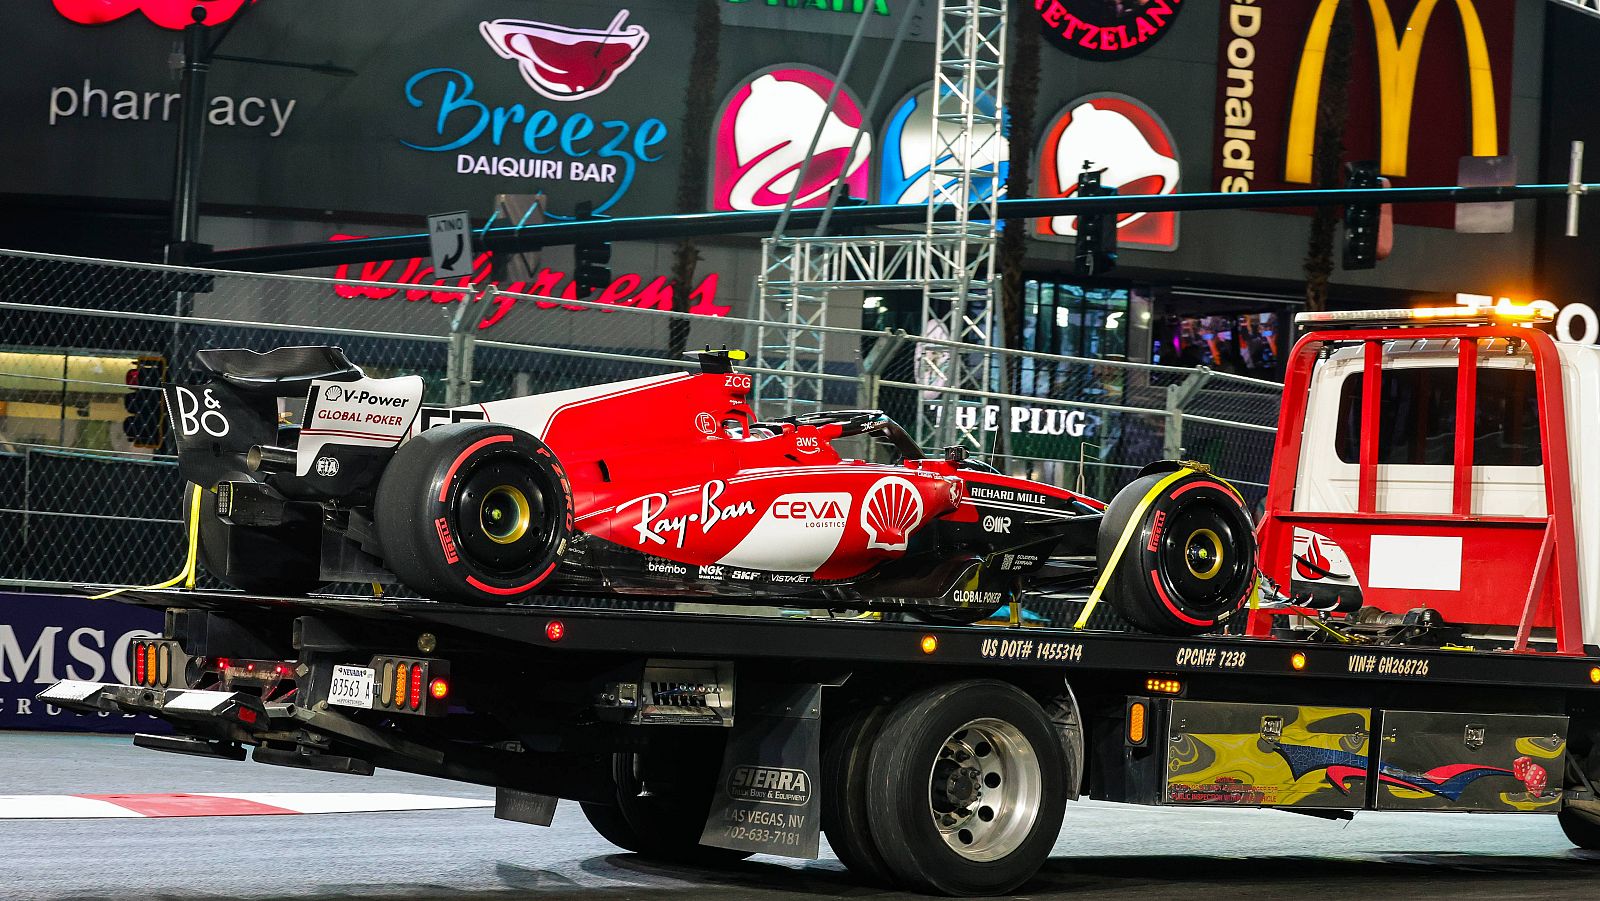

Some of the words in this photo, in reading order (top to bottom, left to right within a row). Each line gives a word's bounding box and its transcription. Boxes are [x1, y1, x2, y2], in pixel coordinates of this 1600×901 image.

[1034, 0, 1180, 51] ETZELAN
[1221, 0, 1262, 194] Donald's
[400, 67, 668, 219] Breeze
[457, 154, 563, 180] DAIQUIRI
[569, 162, 617, 184] BAR
[724, 375, 751, 389] ZCG
[344, 389, 409, 408] V-Power
[318, 409, 362, 423] GLOBAL
[364, 413, 403, 427] POKER
[1010, 406, 1087, 437] PLUG
[796, 436, 818, 447] aws
[971, 487, 1014, 501] RICHARD
[1016, 493, 1046, 505] MILLE
[435, 517, 459, 564] PIRELLI
[1147, 510, 1167, 553] PIRELLI
[648, 561, 687, 574] brembo
[698, 565, 724, 576] NGK
[731, 570, 761, 581] SKF
[953, 590, 983, 603] GLOBAL
[981, 639, 998, 657] US
[1000, 640, 1033, 658] DOT#
[1036, 642, 1083, 661] 1455314
[1176, 647, 1216, 666] CPCN#
[1219, 651, 1247, 668] 7238
[343, 668, 363, 678] NEVADA
[1348, 655, 1377, 673] VIN#
[1378, 656, 1430, 675] GH268726
[332, 678, 360, 698] 83563
[365, 681, 370, 699] A
[732, 768, 806, 791] SIERRA
[767, 790, 774, 799] &
[747, 811, 786, 829] VEGAS,
[788, 814, 805, 829] NV
[722, 825, 801, 846] 702-633-7181
